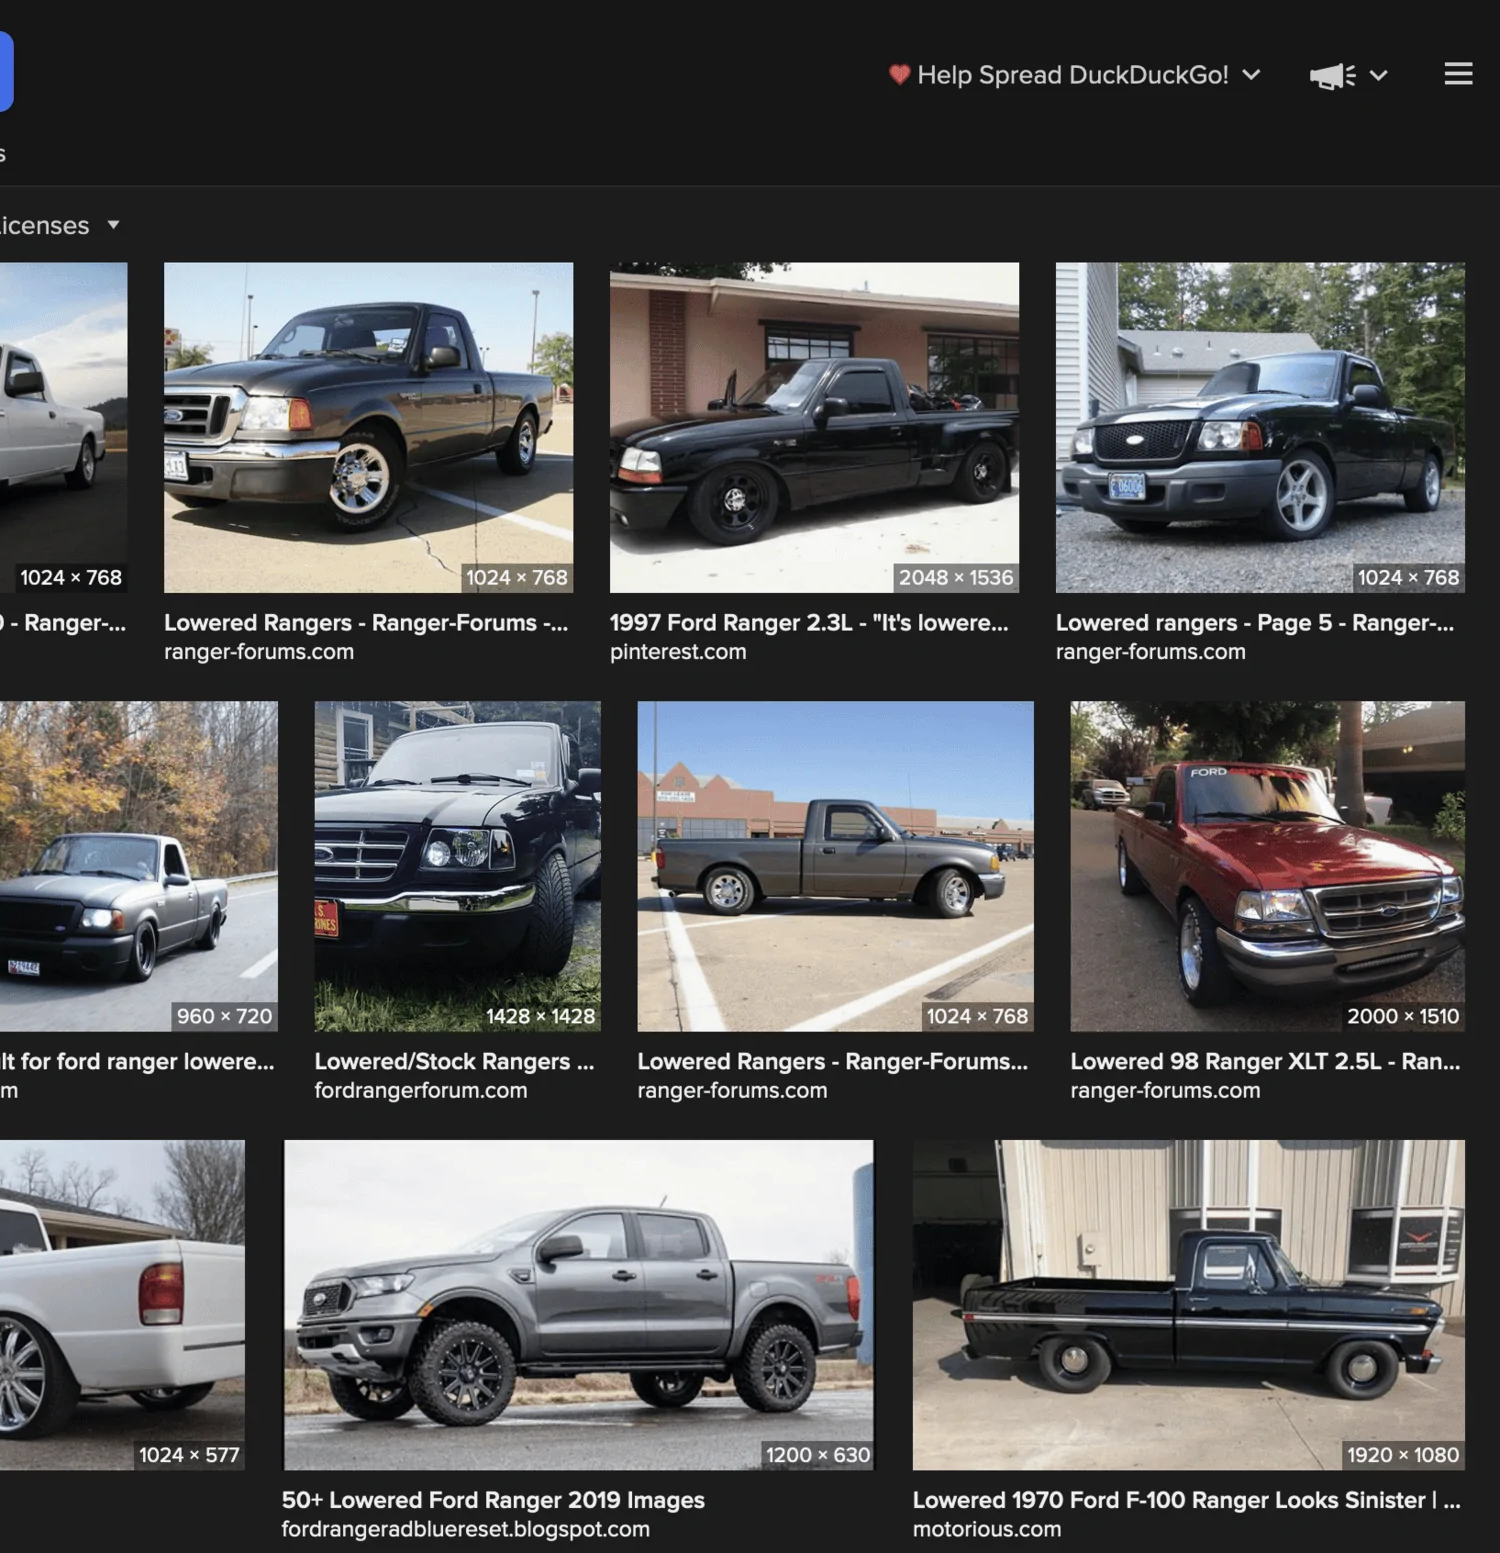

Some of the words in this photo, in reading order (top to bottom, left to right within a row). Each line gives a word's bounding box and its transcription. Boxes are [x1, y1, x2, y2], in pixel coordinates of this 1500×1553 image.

[918, 64, 973, 90] Help
[979, 64, 1062, 90] Spread
[1070, 64, 1229, 85] DuckDuckGo!
[899, 569, 949, 586] 2048
[970, 569, 1014, 586] 1536
[164, 613, 258, 632] Lowered
[264, 613, 353, 637] Rangers
[372, 613, 538, 637] Ranger-Forums
[609, 612, 662, 632] 1997
[667, 613, 717, 632] Ford
[723, 613, 802, 637] Ranger
[806, 612, 854, 632] 2.3L
[872, 612, 912, 632] "It's
[164, 641, 354, 665] ranger-forums.com
[610, 642, 747, 665] pinterest.com
[1056, 641, 1246, 665] ranger-forums.com
[1190, 767, 1228, 778] FORD
[1348, 1008, 1398, 1024] 2000
[1420, 1008, 1459, 1024] 1510
[20, 1051, 52, 1071] for
[56, 1051, 101, 1071] ford
[107, 1055, 179, 1075] ranger
[637, 1051, 731, 1071] Lowered
[737, 1051, 826, 1075] Rangers
[1071, 1051, 1164, 1071] Lowered
[1169, 1051, 1200, 1071] 98
[1205, 1051, 1284, 1075] Ranger
[1287, 1051, 1330, 1071] XLT
[1334, 1051, 1383, 1071] 2.5L
[314, 1080, 528, 1104] fordrangerforum.com
[638, 1080, 828, 1104] ranger-forums.com
[1071, 1080, 1261, 1104] ranger-forums.com
[139, 1447, 184, 1463] 1024
[206, 1447, 240, 1463] 577
[1348, 1447, 1393, 1463] 1920
[1414, 1447, 1460, 1463] 1080
[281, 1490, 324, 1510] 50+
[329, 1490, 423, 1510] Lowered
[429, 1490, 479, 1510] Ford
[485, 1490, 563, 1514] Ranger
[568, 1490, 621, 1510] 2019
[627, 1490, 706, 1514] Images
[913, 1490, 1006, 1510] Lowered
[1011, 1490, 1065, 1510] 1970
[1070, 1490, 1120, 1510] Ford
[1126, 1490, 1186, 1510] F-100
[1192, 1490, 1270, 1514] Ranger
[1275, 1490, 1340, 1510] Looks
[1344, 1490, 1427, 1510] Sinister
[280, 1519, 651, 1542] fordrangeradbluereset.blogspot.com
[913, 1520, 1062, 1538] motorious.com
